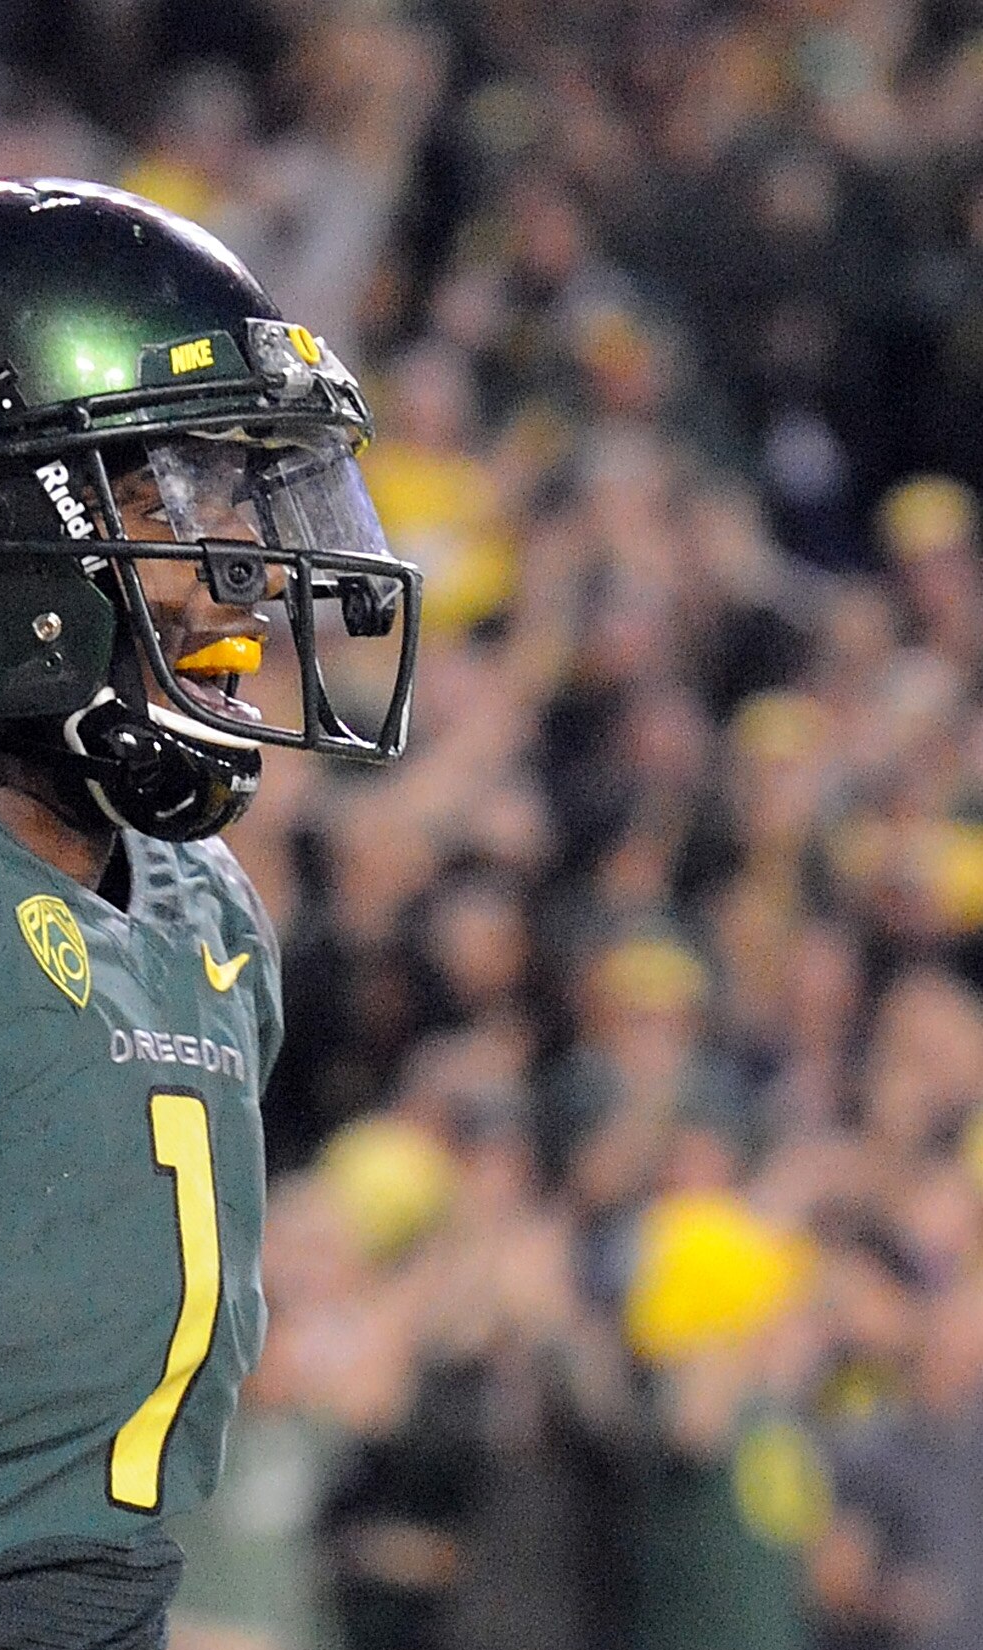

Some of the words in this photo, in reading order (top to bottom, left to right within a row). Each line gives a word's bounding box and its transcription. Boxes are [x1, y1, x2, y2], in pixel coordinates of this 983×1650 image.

[169, 338, 214, 375] NIKE
[35, 459, 109, 574] Riddll
[50, 941, 86, 985] 10
[110, 1028, 245, 1081] OREGON
[108, 1086, 223, 1512] 1
